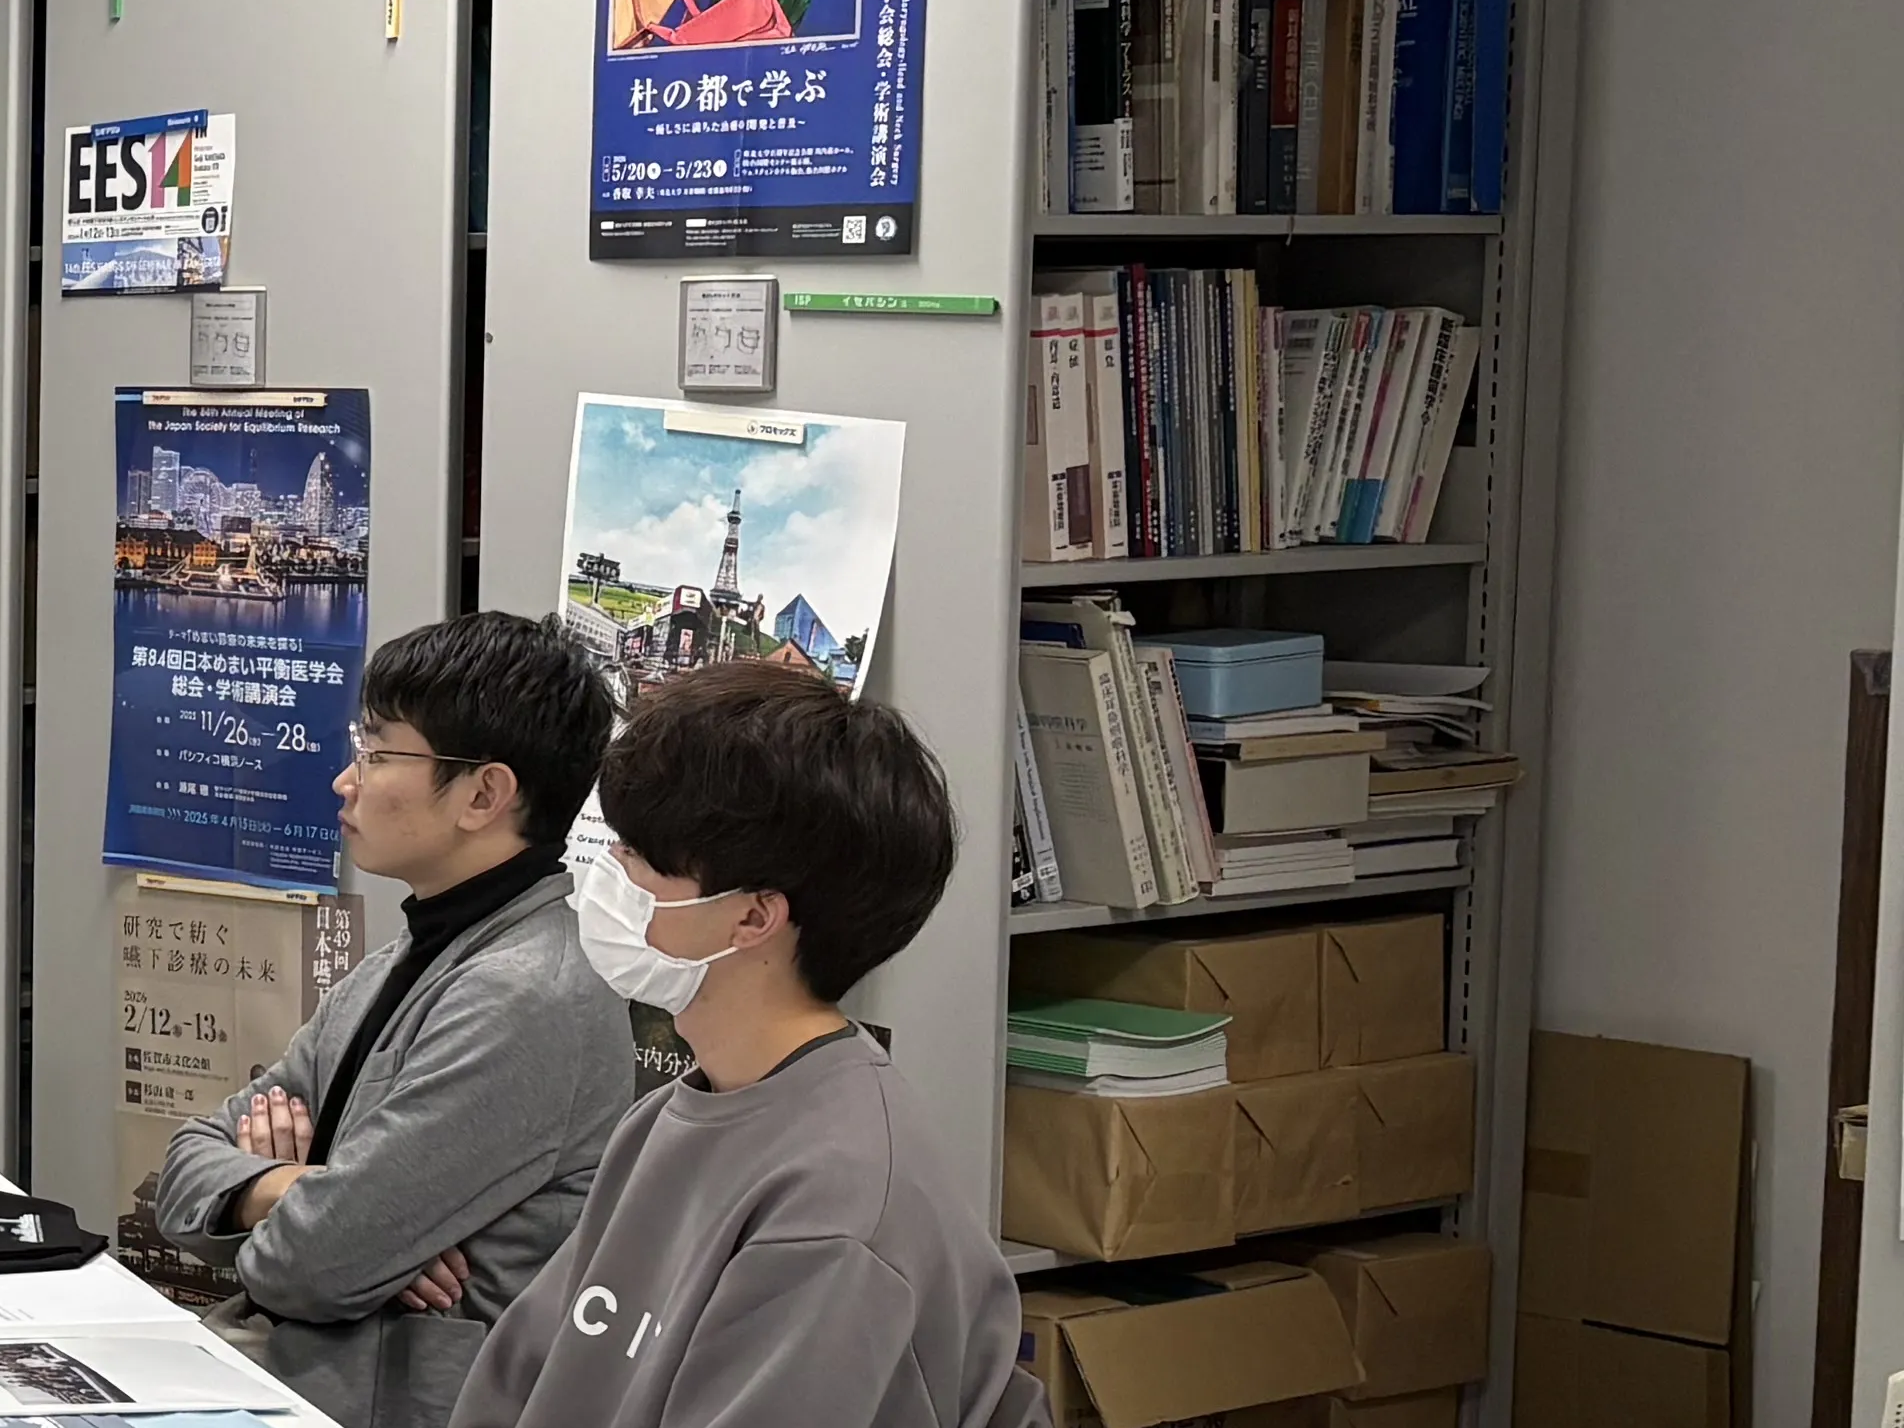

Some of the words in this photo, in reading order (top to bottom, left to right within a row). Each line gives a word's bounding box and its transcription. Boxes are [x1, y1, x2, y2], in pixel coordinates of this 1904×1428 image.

[629, 69, 828, 116] 杜の都で学ぶ
[164, 421, 193, 433] Japan
[195, 421, 228, 433] Society
[297, 423, 342, 435] Research
[131, 645, 345, 686] 第84回日本めまい平衡医学会
[170, 674, 298, 707] 総会・学術講演会
[122, 914, 230, 946] 研究で紡ぐ
[332, 907, 353, 972] 第49回
[122, 945, 277, 984] 嚥下診療の未来
[123, 989, 148, 1005] 2026
